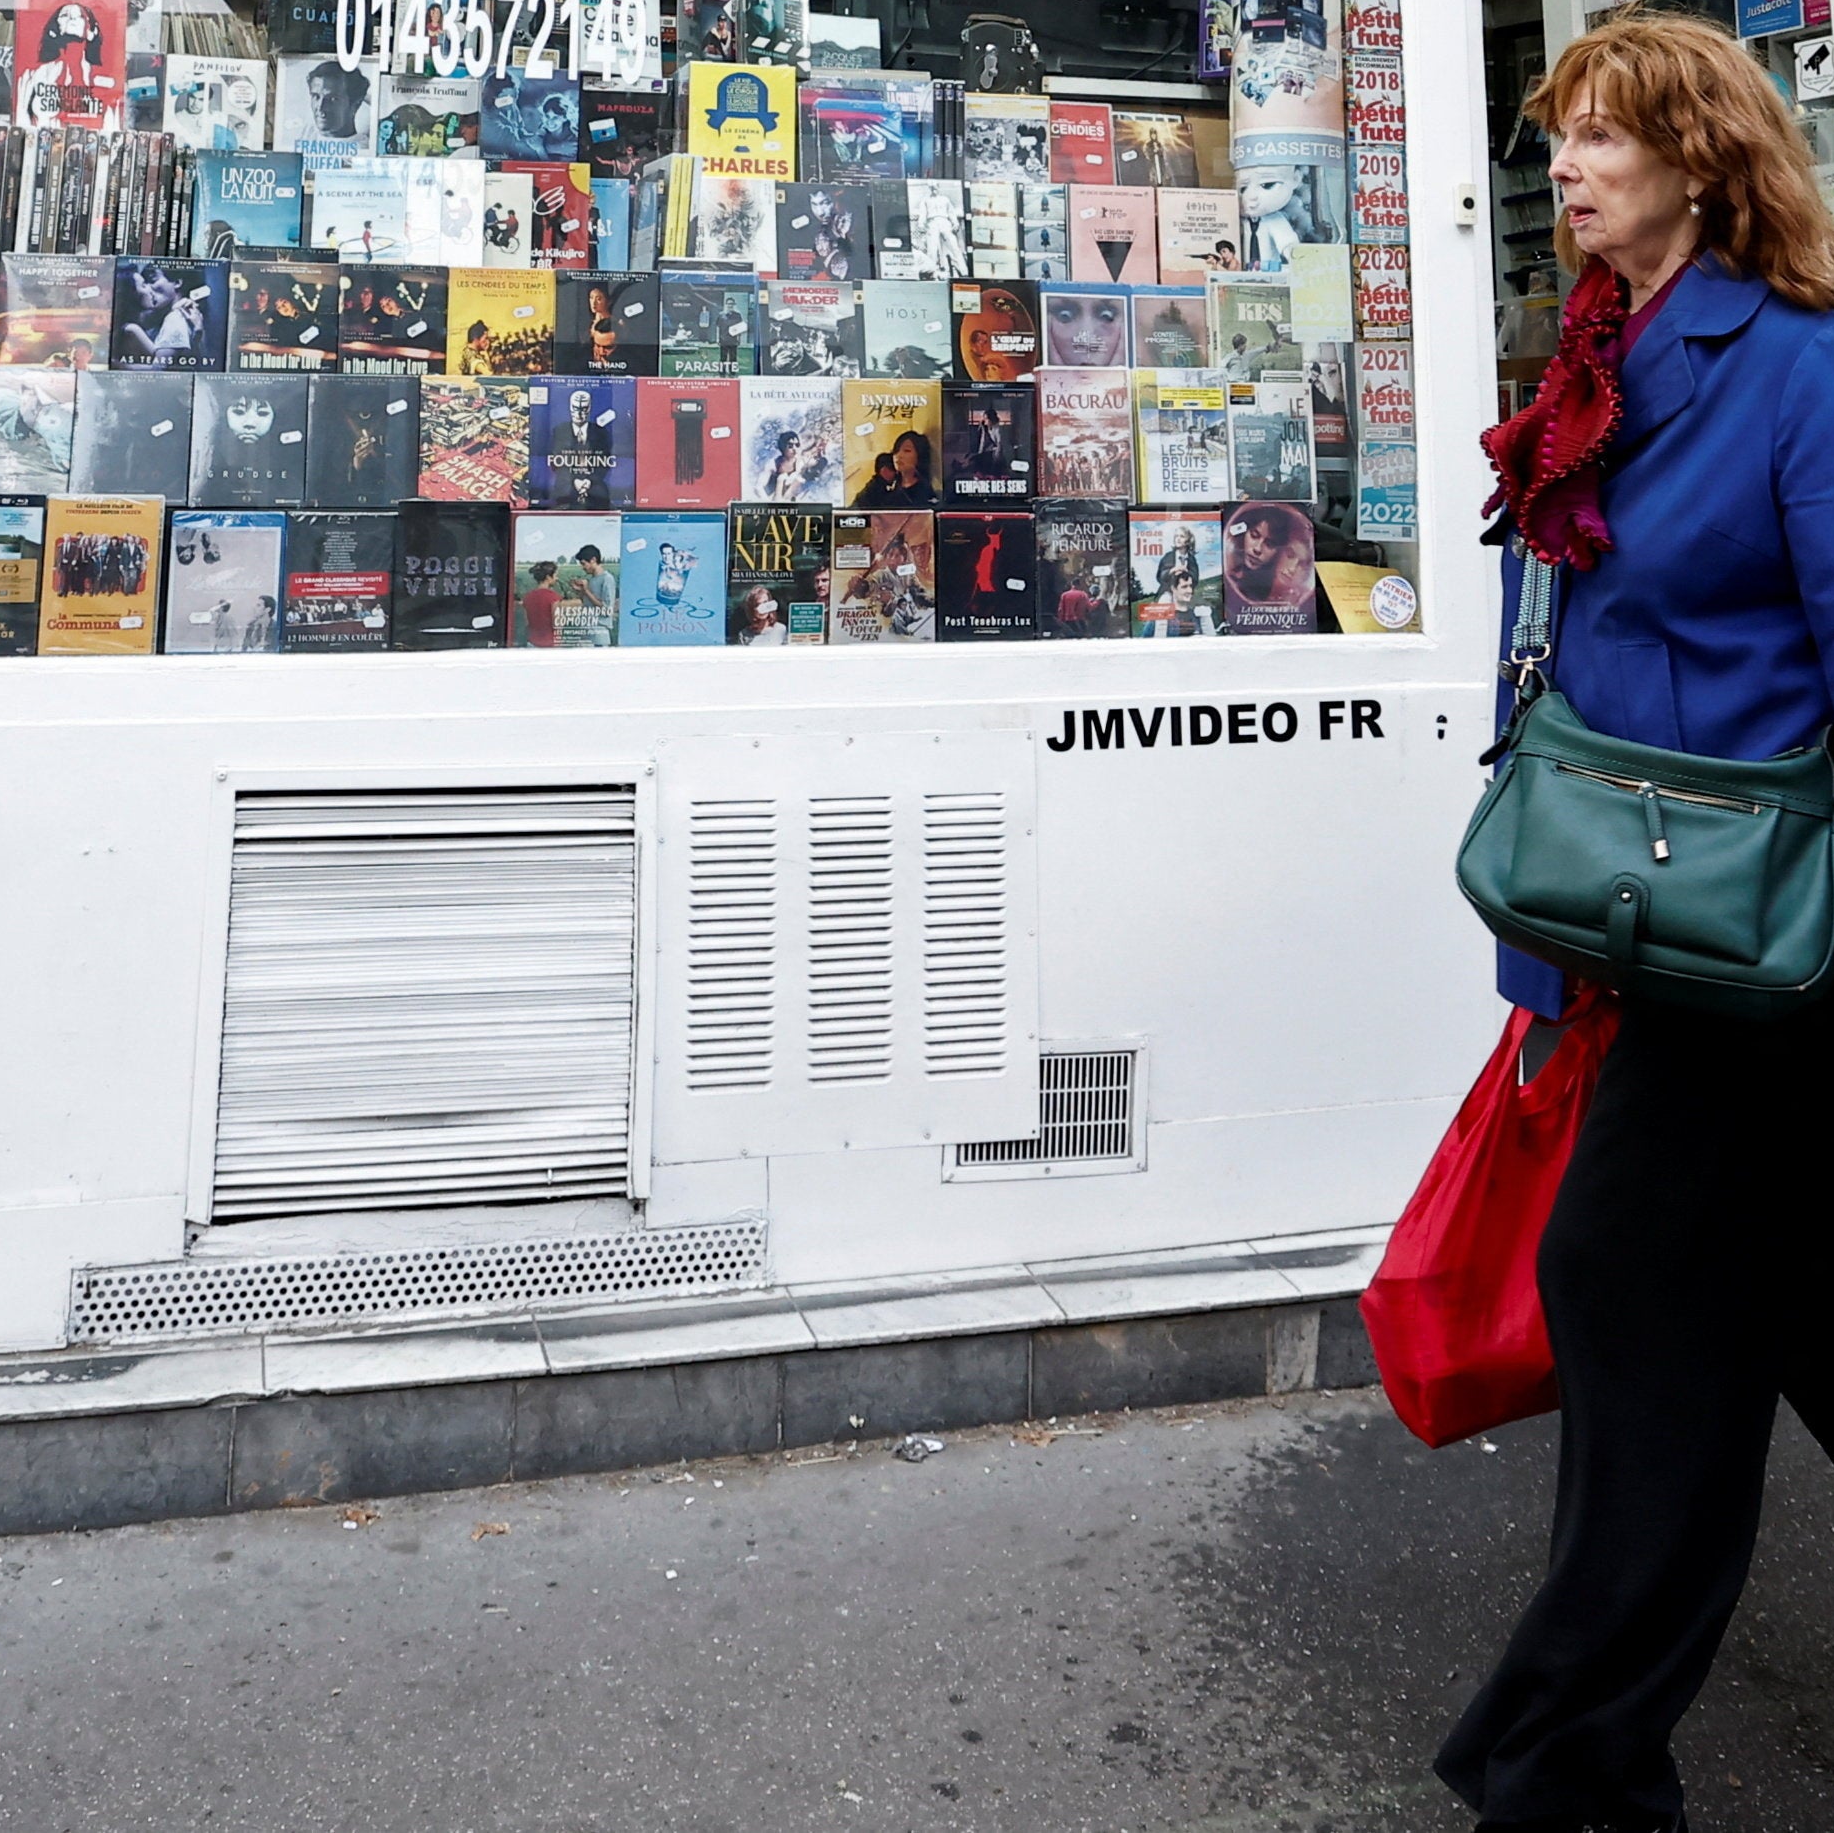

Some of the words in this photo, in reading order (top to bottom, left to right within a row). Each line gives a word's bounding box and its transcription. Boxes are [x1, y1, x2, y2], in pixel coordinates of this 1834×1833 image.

[1354, 70, 1399, 91] 2018
[294, 140, 358, 157] FRANÇOIS
[1254, 142, 1342, 160] CASSETTES
[700, 156, 789, 176] CHARLES
[1359, 155, 1401, 176] 2019
[1359, 248, 1406, 270] 2020
[885, 308, 928, 320] HOST
[1238, 302, 1284, 322] KES
[990, 343, 1036, 353] SERPENT
[119, 355, 135, 366] AS
[143, 355, 174, 366] TEARS
[178, 355, 197, 366] GO
[202, 355, 217, 366] BY
[675, 360, 740, 373] PARASITE
[1362, 349, 1409, 371] 2021
[860, 393, 928, 407] FANTASMES
[1045, 393, 1126, 410] BACURAU
[1289, 397, 1305, 417] LE
[1280, 420, 1308, 443] JOLI
[1162, 444, 1185, 456] LES
[1162, 456, 1209, 469] BRUITS
[207, 470, 288, 479] GRUDGE
[448, 454, 508, 489] SMASH
[1162, 468, 1179, 481] DE
[430, 461, 497, 500] PALACE
[1162, 480, 1209, 493] RECIFE
[1360, 503, 1416, 524] 2022
[733, 515, 825, 543] L'AVE
[839, 518, 866, 528] HDR
[1050, 523, 1113, 536] RICARDO
[1050, 538, 1113, 552] PEINTURE
[1133, 539, 1164, 557] Jim
[405, 555, 494, 576] POGGI
[732, 543, 795, 572] NIR
[404, 577, 498, 596] VINEL
[1381, 580, 1414, 603] VITRIER
[553, 606, 614, 617] ALESSANDRO
[1235, 611, 1308, 627] VÉRONIQUE
[553, 616, 600, 627] COMODIN
[637, 621, 709, 635] POISON
[944, 615, 965, 627] Post
[969, 615, 1009, 627] Tenebras
[1012, 616, 1032, 627] Lux
[1046, 701, 1299, 753] JMVIDEO
[1318, 699, 1385, 741] FR
